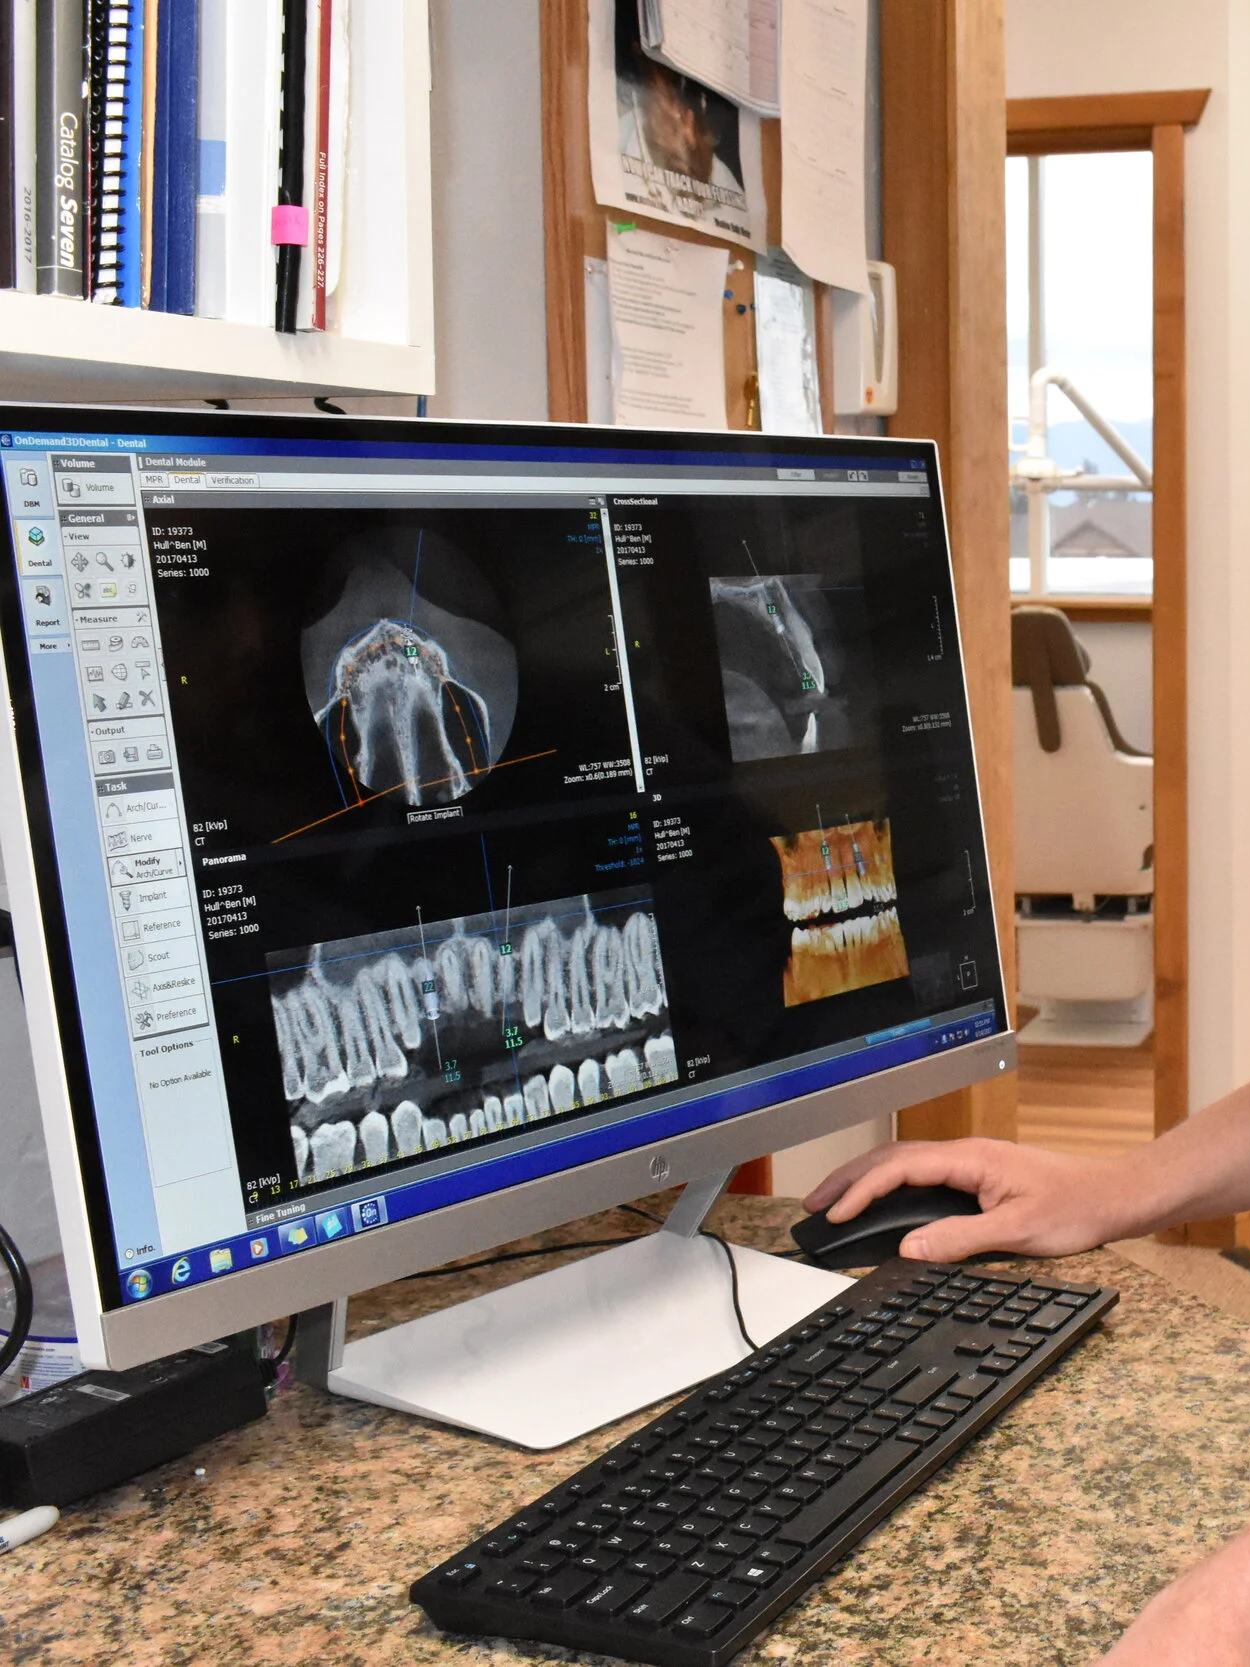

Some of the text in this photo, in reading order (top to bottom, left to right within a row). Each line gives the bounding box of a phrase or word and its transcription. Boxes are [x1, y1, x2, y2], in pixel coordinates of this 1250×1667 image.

[318, 152, 326, 168] Full
[318, 170, 326, 195] Index
[54, 112, 78, 267] Catalog Seven
[318, 202, 325, 213] on
[23, 188, 33, 264] 2016-2017
[317, 216, 325, 244] Pages
[14, 436, 146, 449] OnDemand3DDental Dental
[60, 458, 95, 468] Volume
[145, 457, 206, 467] Dental Module
[146, 476, 163, 484] MPR
[174, 475, 201, 485] Dental
[211, 476, 254, 485] Verification
[86, 483, 114, 492] Volume
[152, 496, 174, 504] Axial
[68, 514, 104, 524] General
[68, 532, 90, 541] View
[152, 527, 194, 536] ID: 19373
[192, 540, 207, 550] [M]
[28, 559, 52, 568] Dental
[156, 555, 197, 564] 20170413
[189, 568, 209, 576] 1000
[36, 619, 60, 627] Report
[80, 615, 118, 624] Measure
[40, 642, 57, 650] More
[181, 676, 188, 684] R
[95, 726, 125, 736] Output
[104, 782, 127, 792] Task
[410, 808, 460, 823] Rotate Implant
[193, 823, 203, 832] 82
[130, 834, 152, 842] Nerve
[195, 837, 205, 846] CT
[135, 856, 160, 867] Modify
[202, 853, 246, 866] Panorama
[136, 868, 173, 878] Arch/Curve
[202, 885, 242, 898] ID: 19373
[243, 896, 256, 908] [M]
[207, 912, 248, 925] 20170413
[144, 919, 181, 932] Reference
[208, 924, 259, 940] Series: 1000
[501, 944, 512, 954] 12
[148, 951, 170, 962] Scout
[156, 1006, 196, 1022] Preference
[506, 1027, 518, 1036] 3.7
[233, 1035, 239, 1044] R
[505, 1038, 523, 1049] 11.5
[140, 1039, 194, 1057] Tool Options
[149, 1069, 212, 1089] No Option Available
[247, 1181, 257, 1190] 82
[270, 1185, 280, 1195] 13
[289, 1180, 298, 1189] 17
[256, 1204, 306, 1224] Fine Tuning
[136, 1244, 156, 1255] Info.
[608, 1536, 623, 1545] W
[635, 1561, 647, 1569] A
